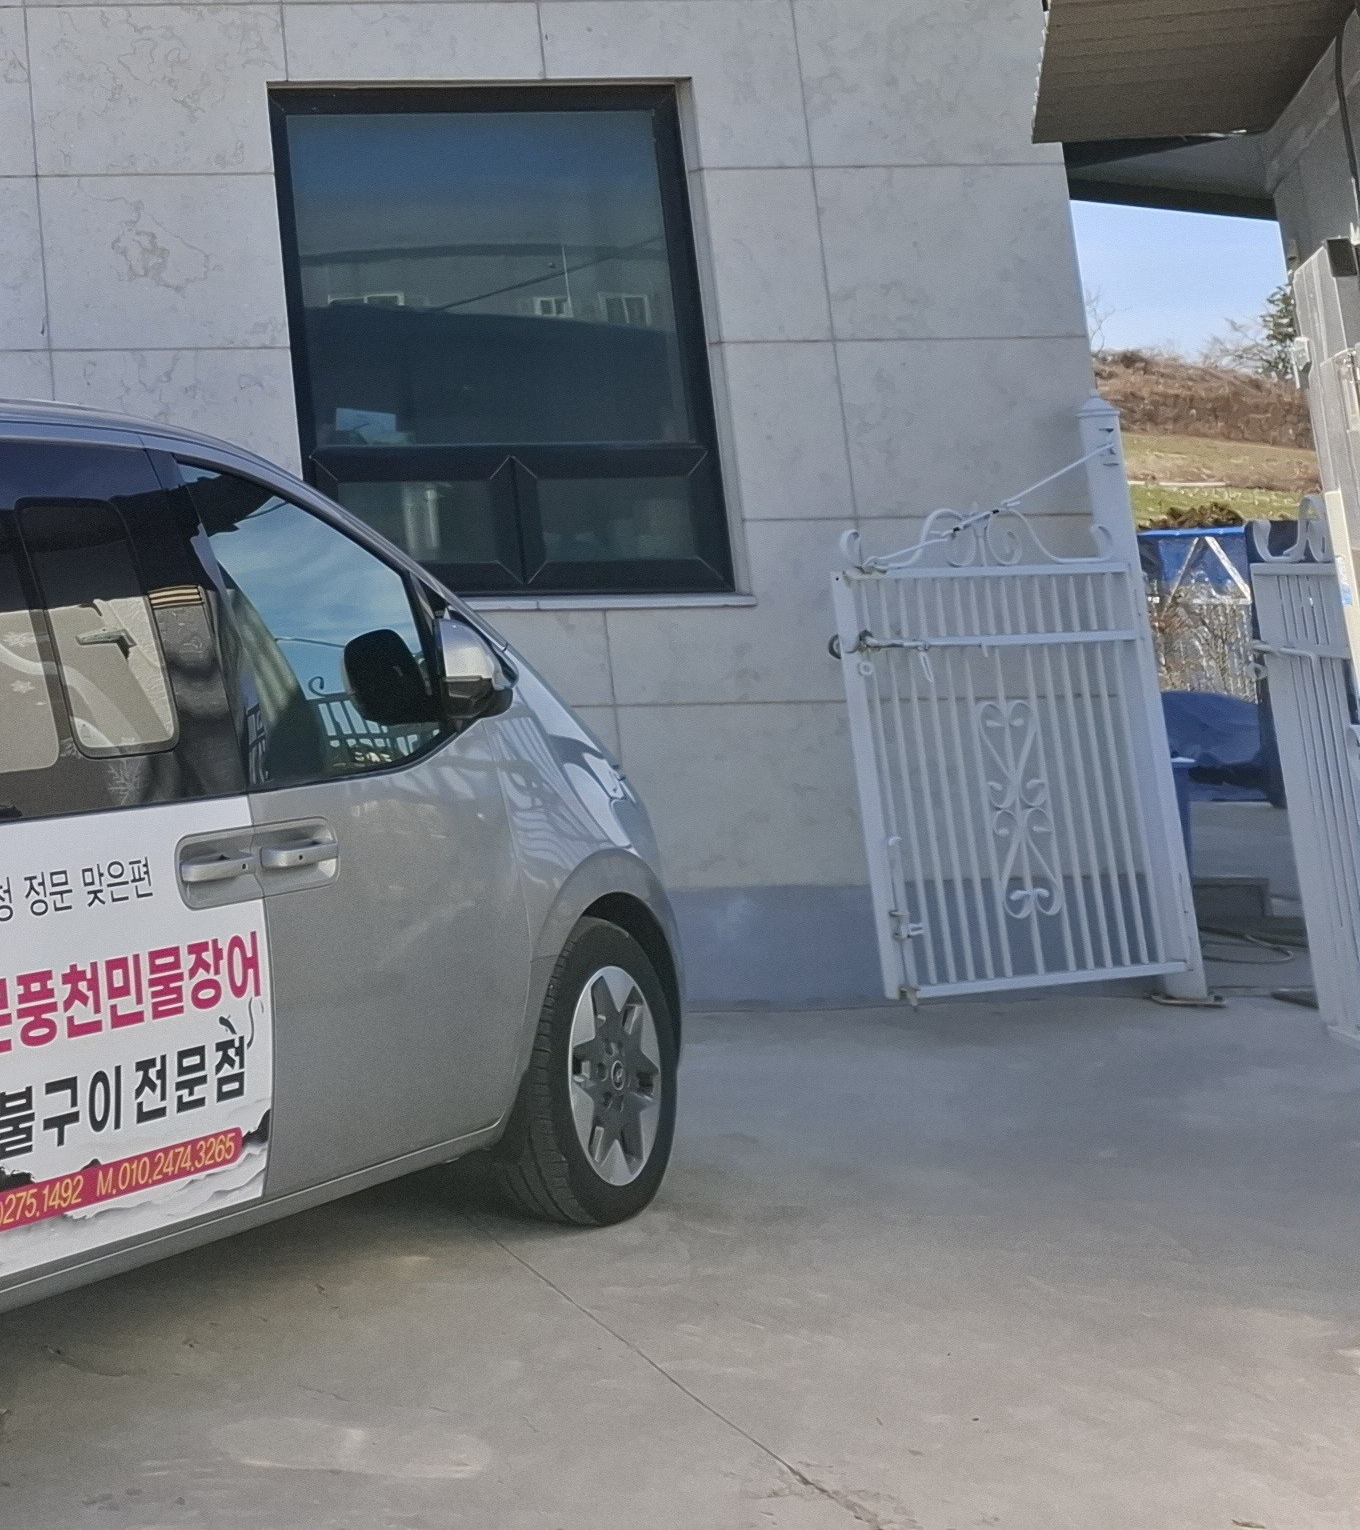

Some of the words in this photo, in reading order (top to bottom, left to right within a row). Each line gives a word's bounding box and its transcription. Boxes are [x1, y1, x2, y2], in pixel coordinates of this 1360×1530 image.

[23, 869, 74, 917] 정문
[80, 855, 154, 908] 맞은편
[134, 1034, 247, 1126] 전문점
